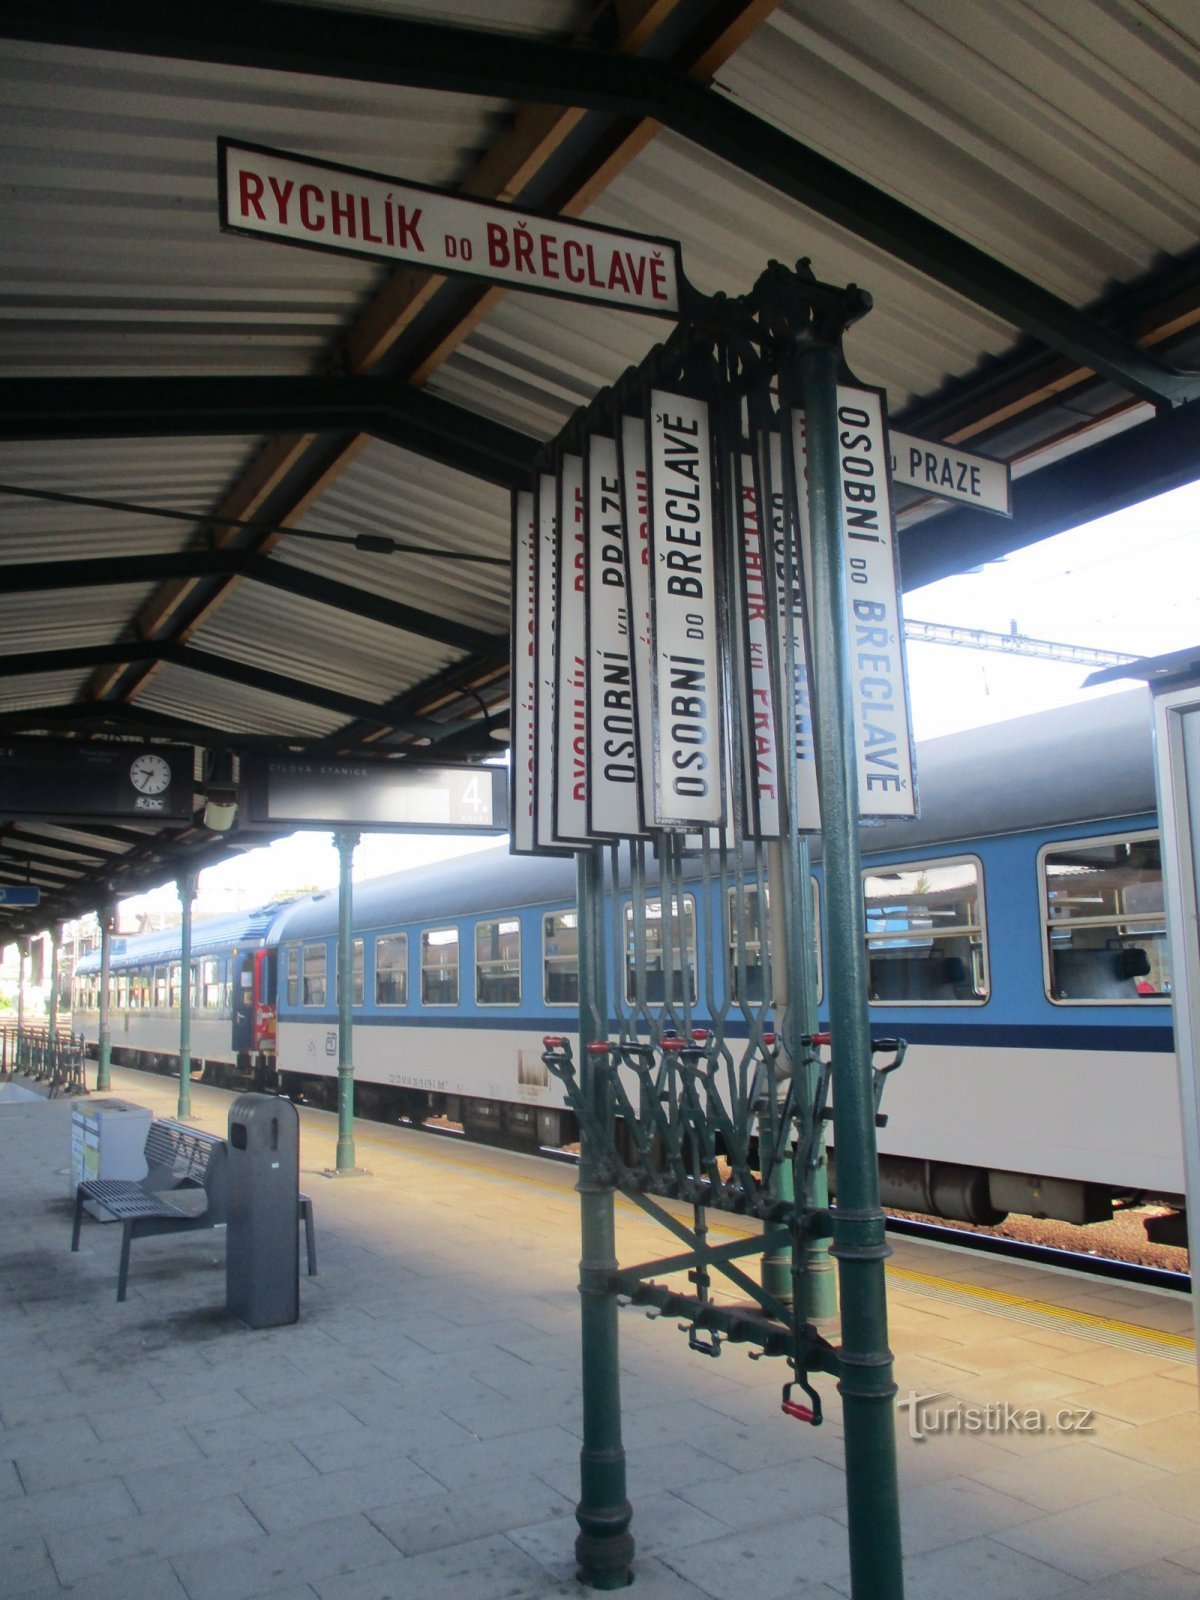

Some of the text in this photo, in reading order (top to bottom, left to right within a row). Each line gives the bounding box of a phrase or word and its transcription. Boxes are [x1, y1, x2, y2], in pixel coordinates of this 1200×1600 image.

[238, 169, 669, 301] RYCHLÍK DO BŘECLAVĚ
[655, 412, 704, 600] BŘECLAVĚ
[909, 446, 982, 497] PRAZE
[685, 613, 705, 640] DO
[838, 405, 907, 792] OSOBNÍ DO BŘECLAVĚ
[661, 651, 709, 798] OSOBNÍ
